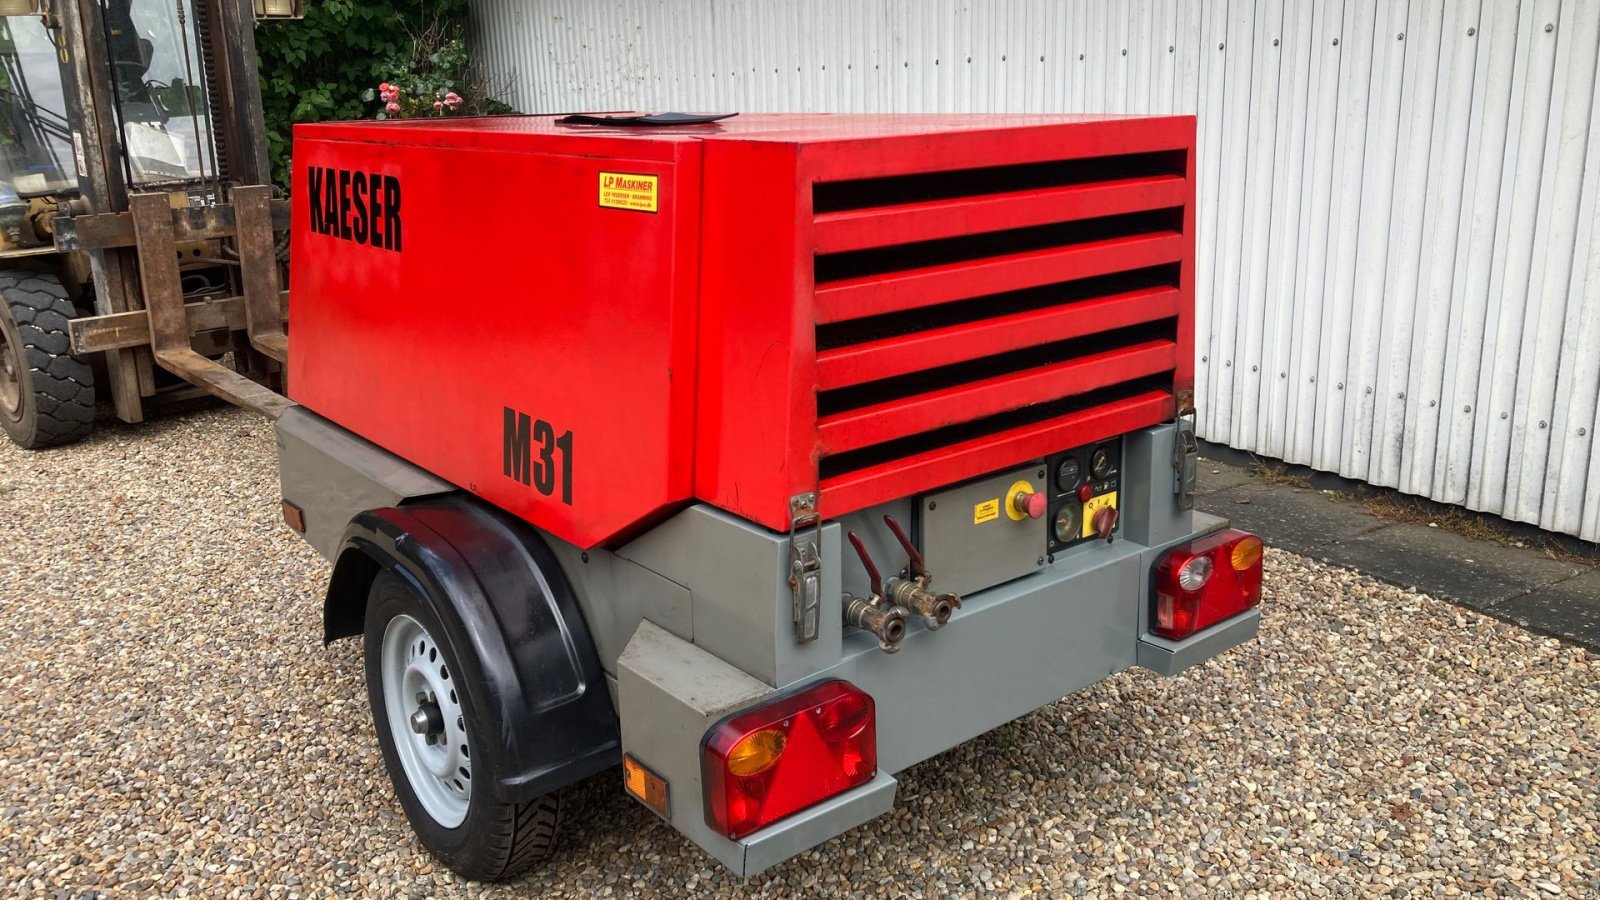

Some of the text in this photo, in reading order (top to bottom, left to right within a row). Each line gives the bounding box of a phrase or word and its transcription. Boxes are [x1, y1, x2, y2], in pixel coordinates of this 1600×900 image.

[308, 166, 403, 253] KAESER
[604, 176, 653, 191] LP MASKINER
[503, 406, 573, 506] M31
